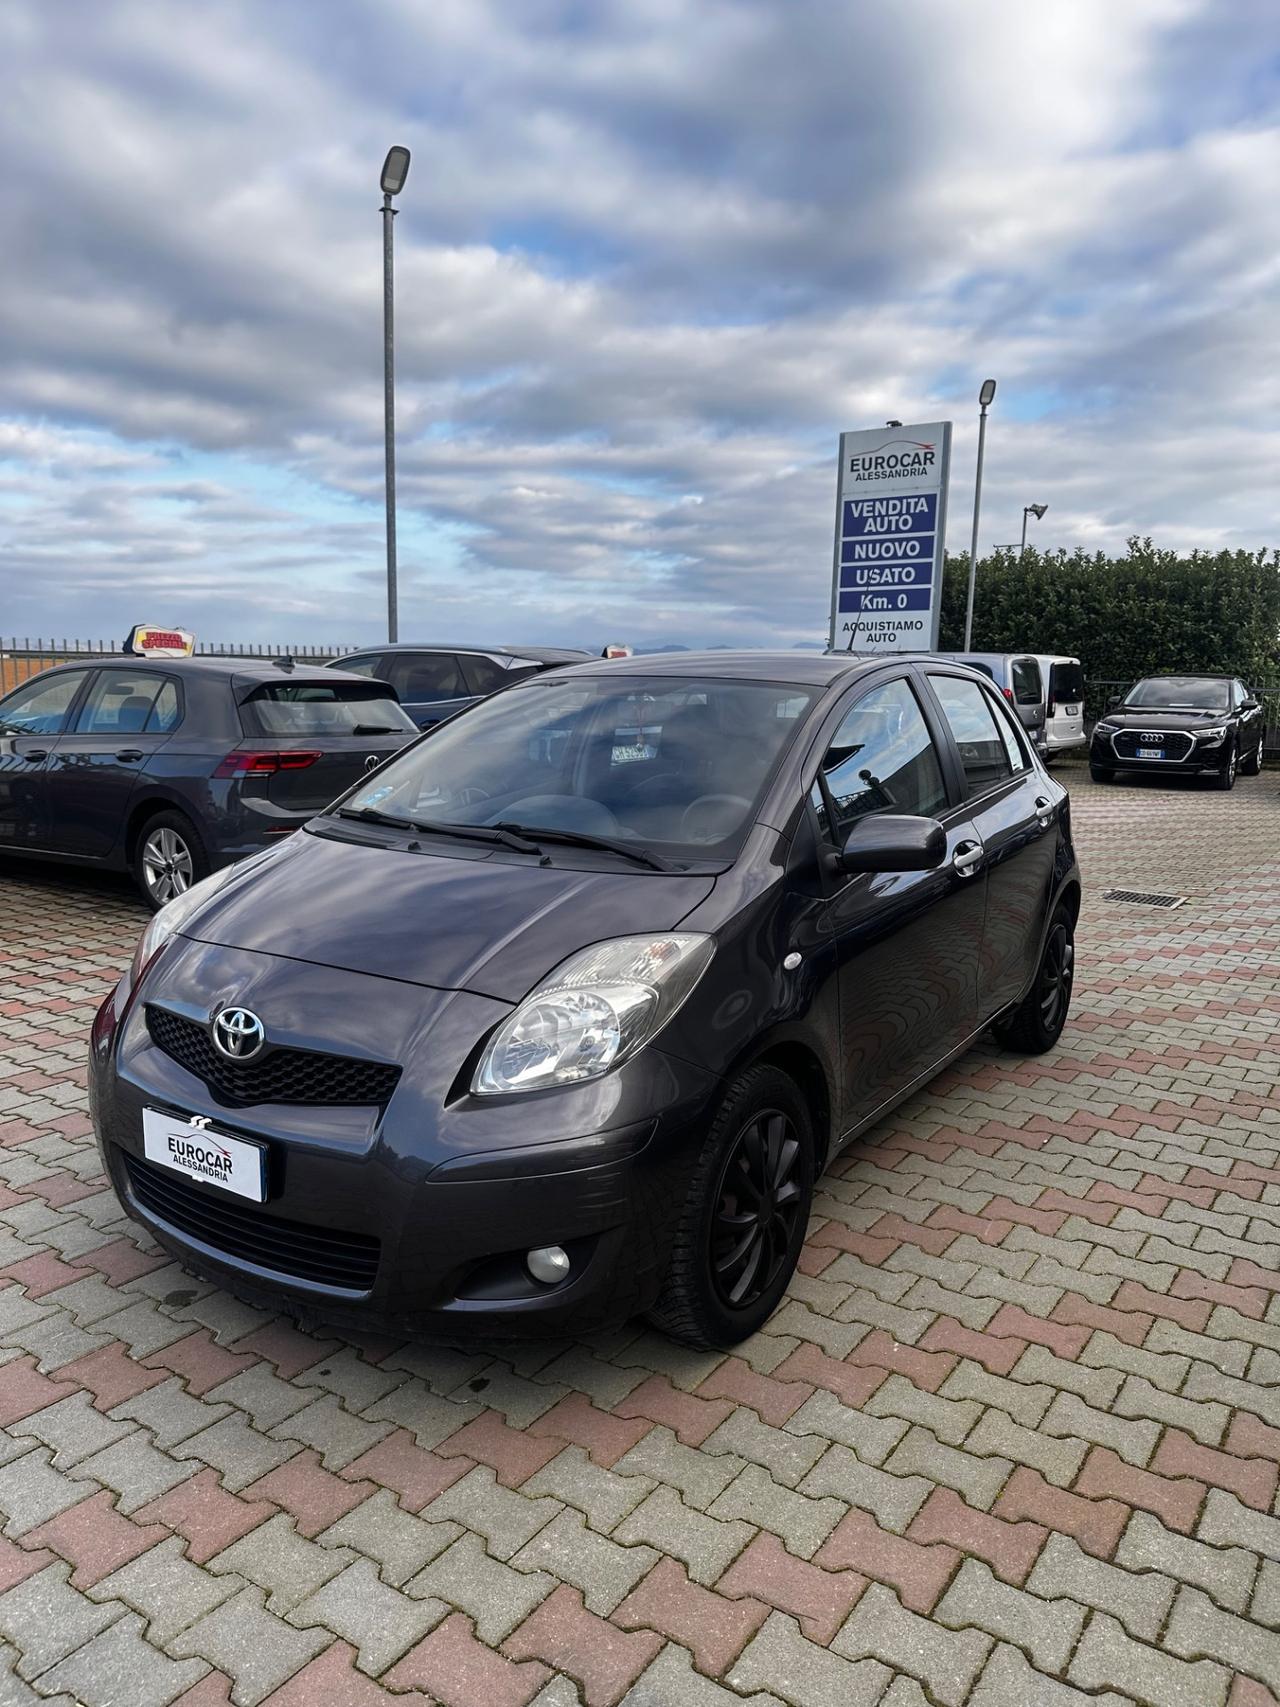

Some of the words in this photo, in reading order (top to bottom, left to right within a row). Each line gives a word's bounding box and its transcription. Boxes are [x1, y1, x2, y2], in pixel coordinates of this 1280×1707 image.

[850, 451, 935, 473] EUROCAR
[855, 467, 928, 482] ALESSANDRIA
[850, 497, 928, 518] VENDITA
[863, 514, 913, 533] AUTO
[854, 540, 920, 560] NUOVO
[856, 566, 916, 585] USATO
[861, 594, 892, 610] Km.
[897, 593, 908, 609] 0
[842, 620, 923, 632] ACQUISTIAMO
[866, 632, 897, 643] AUTO
[167, 1136, 233, 1175] EUROCAR
[173, 1153, 229, 1183] ALESSANDRIA
